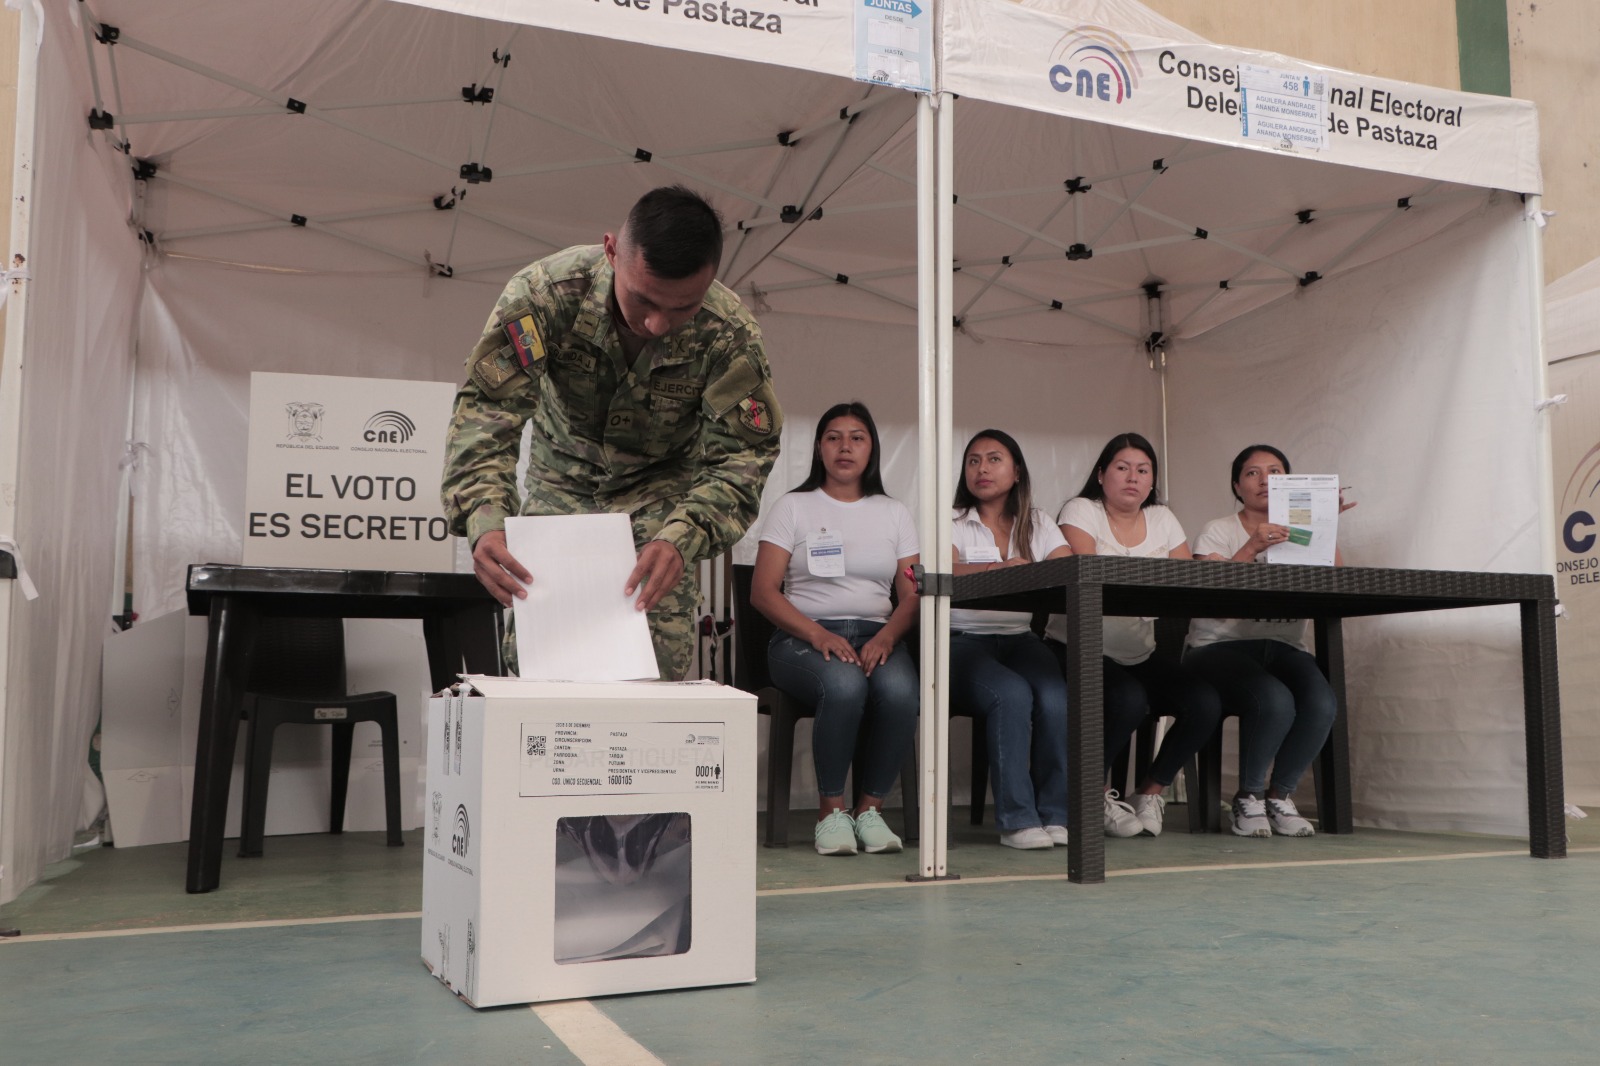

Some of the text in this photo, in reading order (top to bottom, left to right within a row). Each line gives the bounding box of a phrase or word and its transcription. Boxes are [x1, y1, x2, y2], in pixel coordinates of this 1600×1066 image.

[870, 0, 913, 13] JUNTAS
[662, 0, 782, 34] Pastaza
[884, 14, 904, 23] DESDE
[884, 48, 904, 56] HASTA
[1049, 64, 1110, 101] CNE
[1280, 73, 1296, 81] JUNTA
[1158, 50, 1240, 92] Consej
[1370, 89, 1462, 128] Electoral
[1283, 81, 1299, 92] 458
[1256, 96, 1287, 106] AGUILERA
[1287, 100, 1316, 111] ANDRADE
[1255, 103, 1318, 120] ANANDA MONSERRAT
[1257, 120, 1317, 135] AGUILERA ANDRADE
[1356, 117, 1438, 151] Pastaza
[1256, 129, 1319, 144] ANANDA MONSERRAT
[653, 381, 704, 396] EJERCIT
[364, 430, 397, 444] CNE
[286, 473, 417, 501] EL VOTO
[249, 512, 450, 541] ES SECRETO
[1556, 558, 1599, 573] ONSEJO
[695, 765, 713, 777] 0001
[608, 775, 632, 785] 1600105
